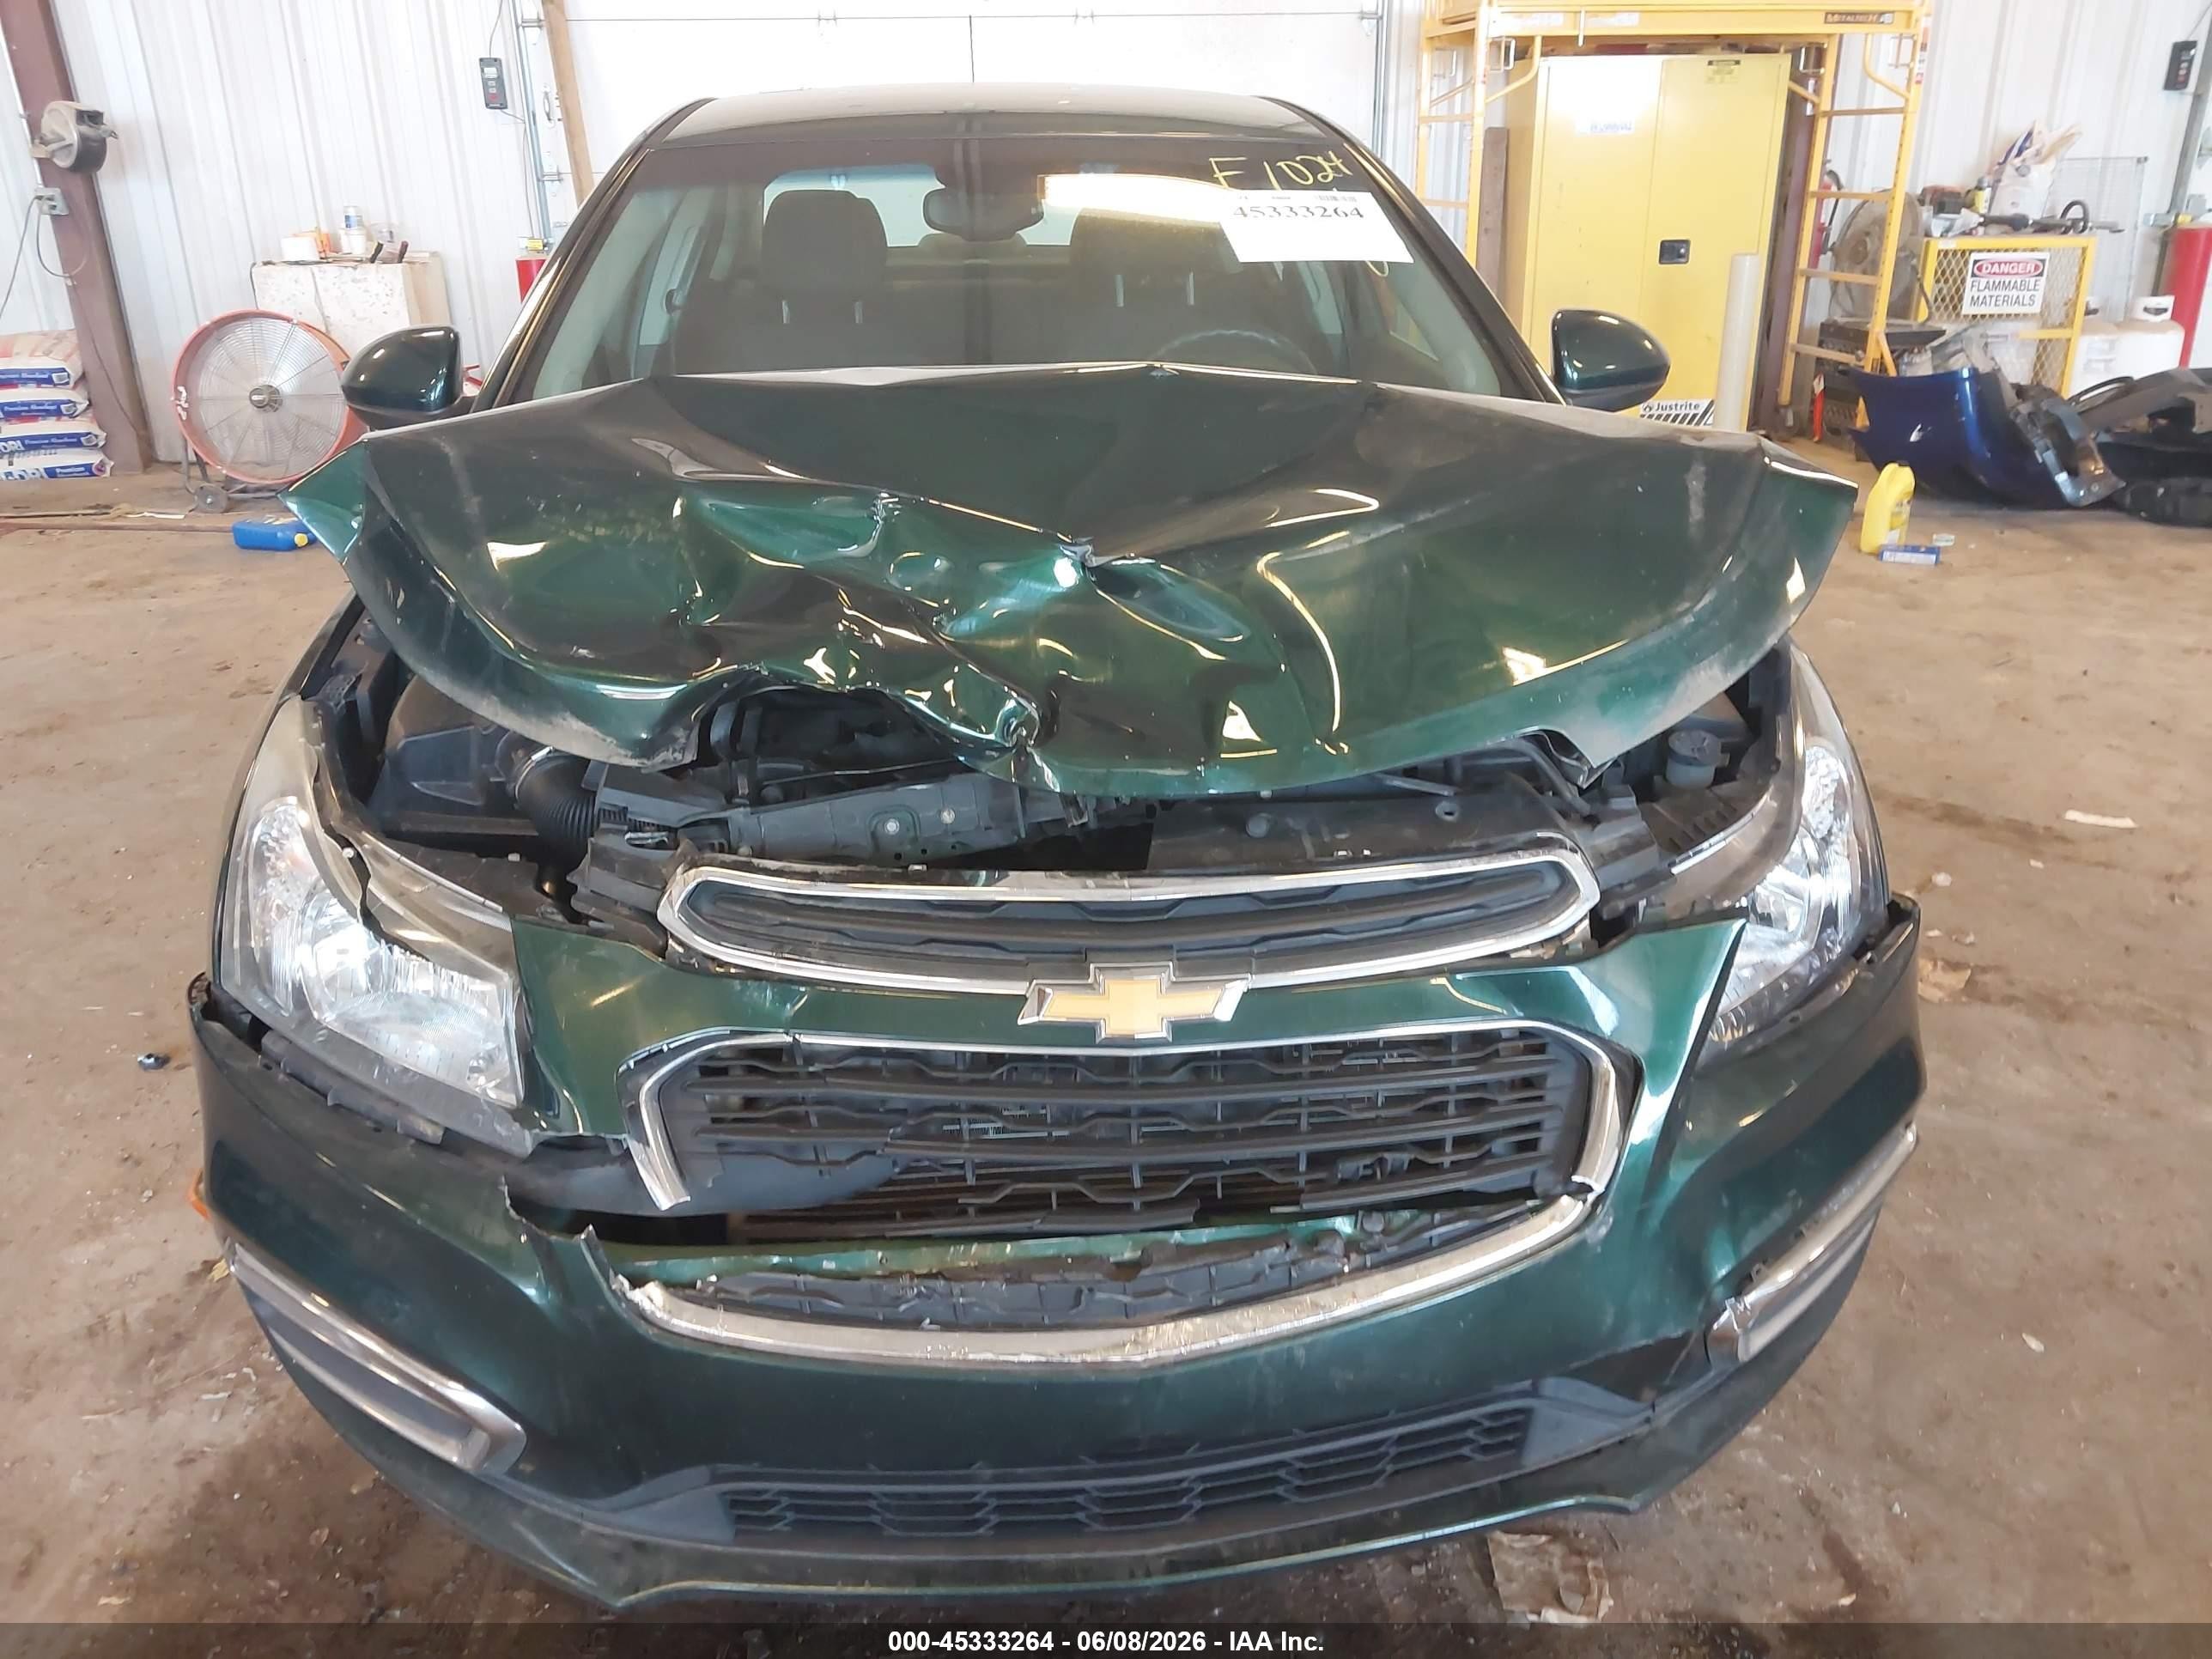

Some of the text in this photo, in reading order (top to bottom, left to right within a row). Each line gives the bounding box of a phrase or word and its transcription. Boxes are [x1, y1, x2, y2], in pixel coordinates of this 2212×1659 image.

[1209, 156, 1247, 189] F
[1232, 205, 1364, 219] 45333264
[1982, 262, 2035, 275] DANGER
[1970, 279, 2041, 293] FLAMMABLE
[1969, 295, 2037, 307] MATERIALS
[1655, 401, 1700, 412] Justrite
